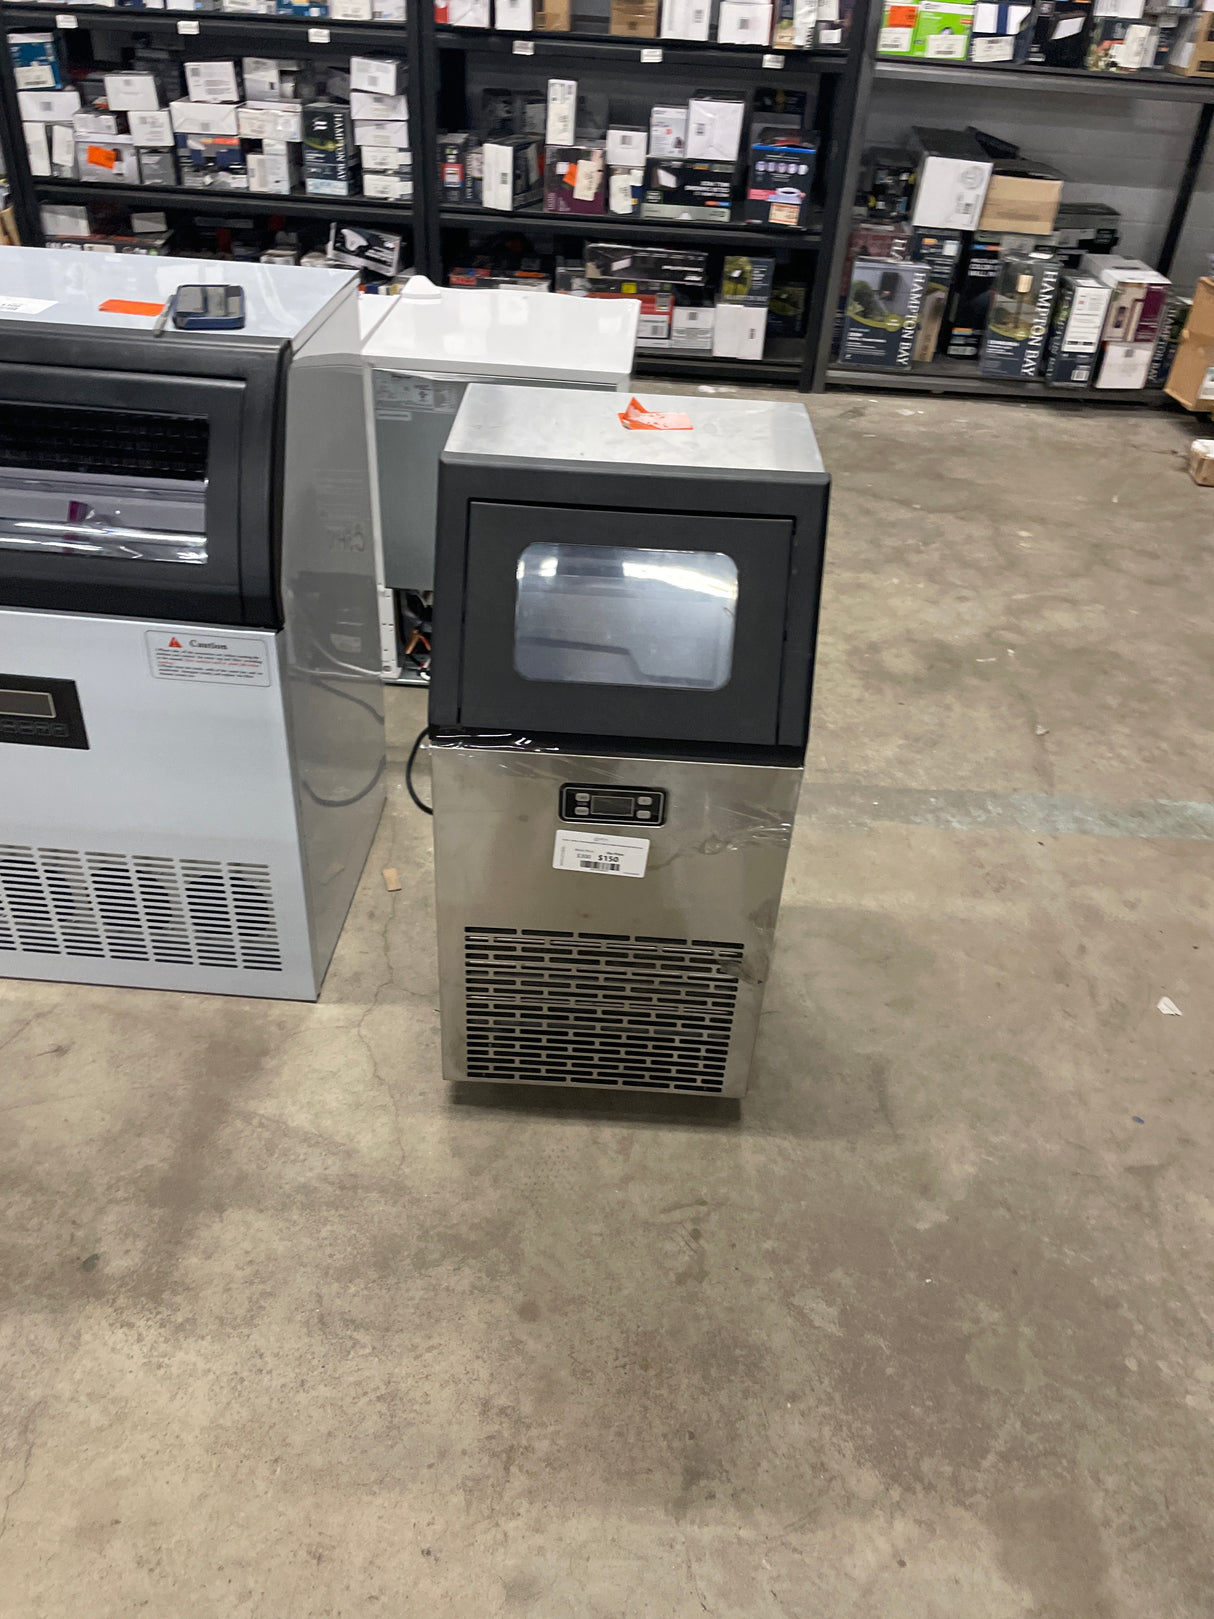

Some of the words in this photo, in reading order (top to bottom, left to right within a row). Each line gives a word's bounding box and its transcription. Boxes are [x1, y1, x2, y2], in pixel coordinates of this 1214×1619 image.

[902, 272, 927, 339] HAMPTON
[1027, 270, 1059, 346] HAMPTON
[896, 342, 913, 366] BAY
[1021, 349, 1040, 376] BAY
[189, 639, 228, 650] Caution
[597, 854, 620, 863] $150
